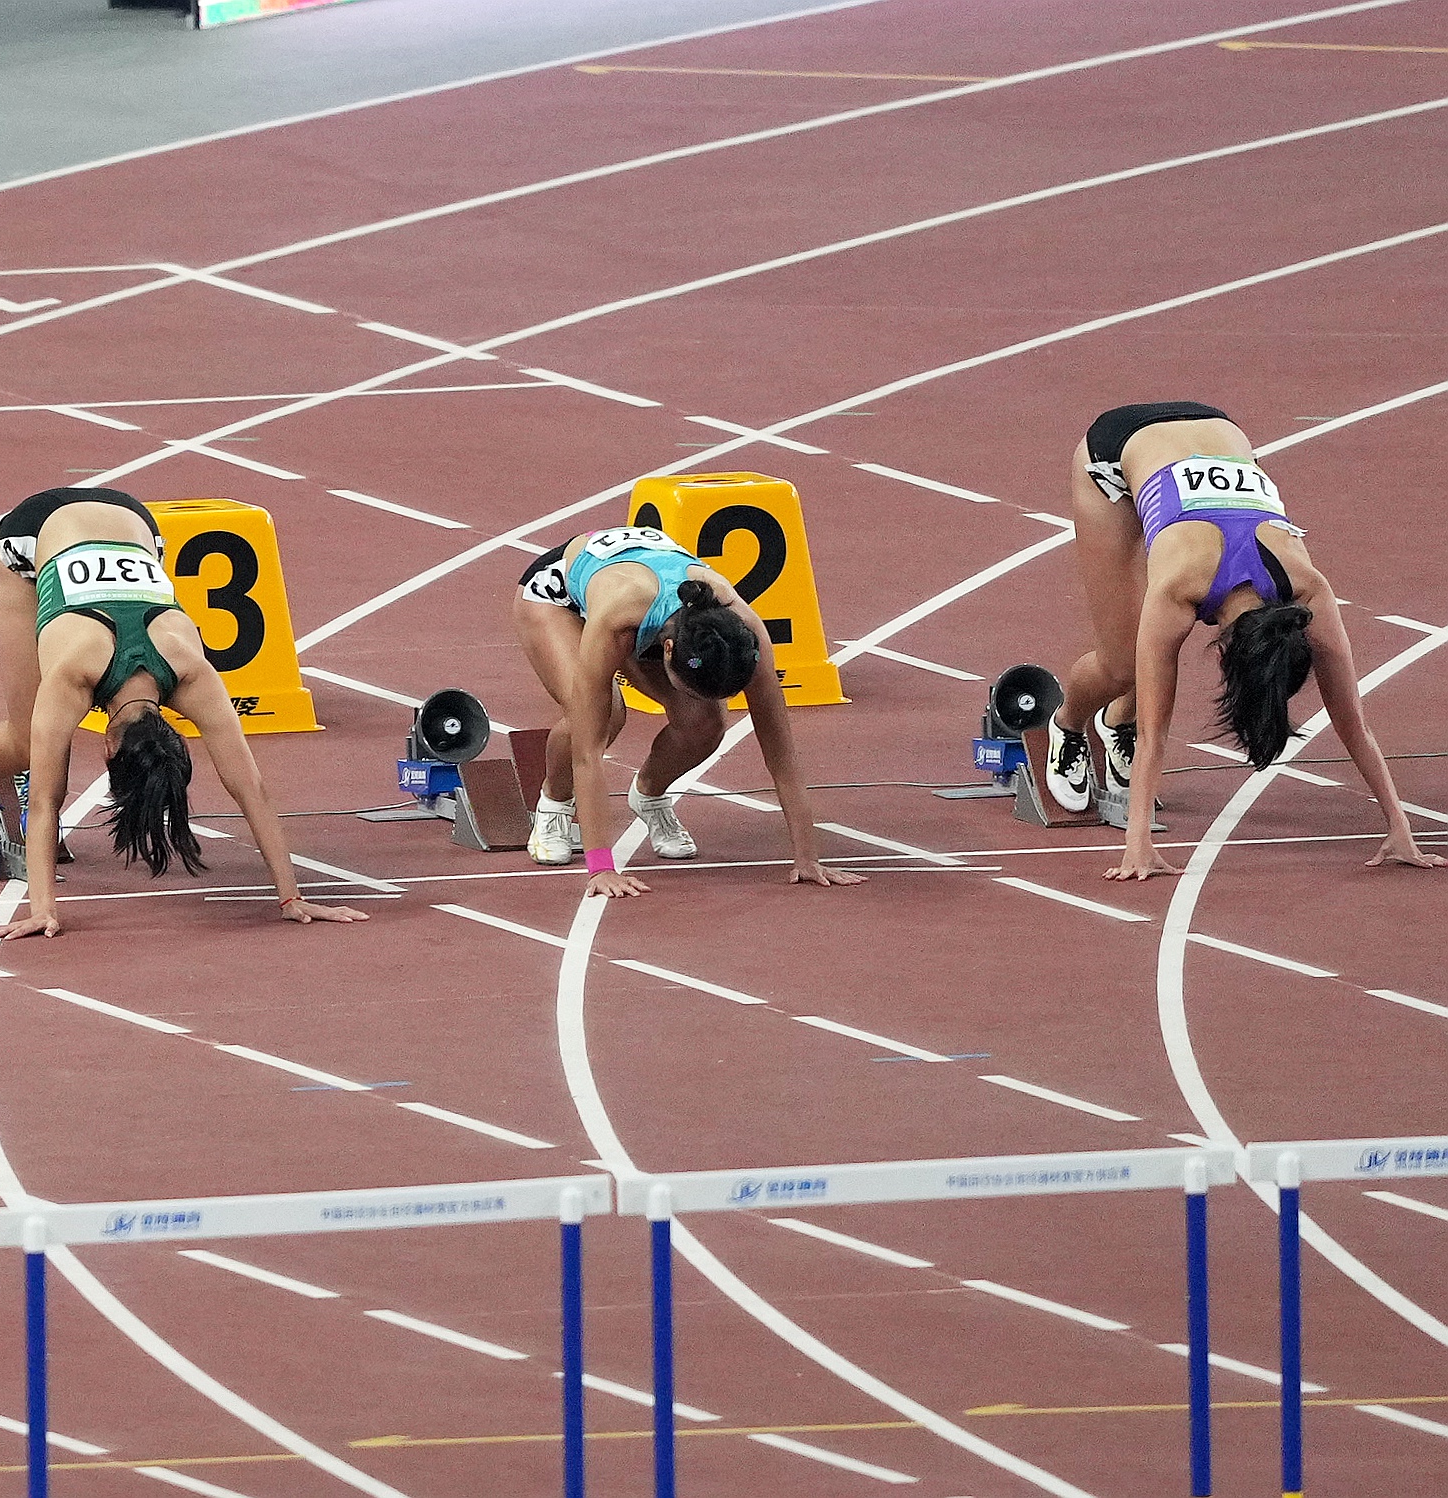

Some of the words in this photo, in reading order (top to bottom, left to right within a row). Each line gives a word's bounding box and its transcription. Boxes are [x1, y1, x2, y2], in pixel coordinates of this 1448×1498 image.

[1182, 466, 1274, 497] 1794
[68, 549, 162, 584] 1370
[175, 531, 265, 672] 3
[697, 505, 792, 644] 2
